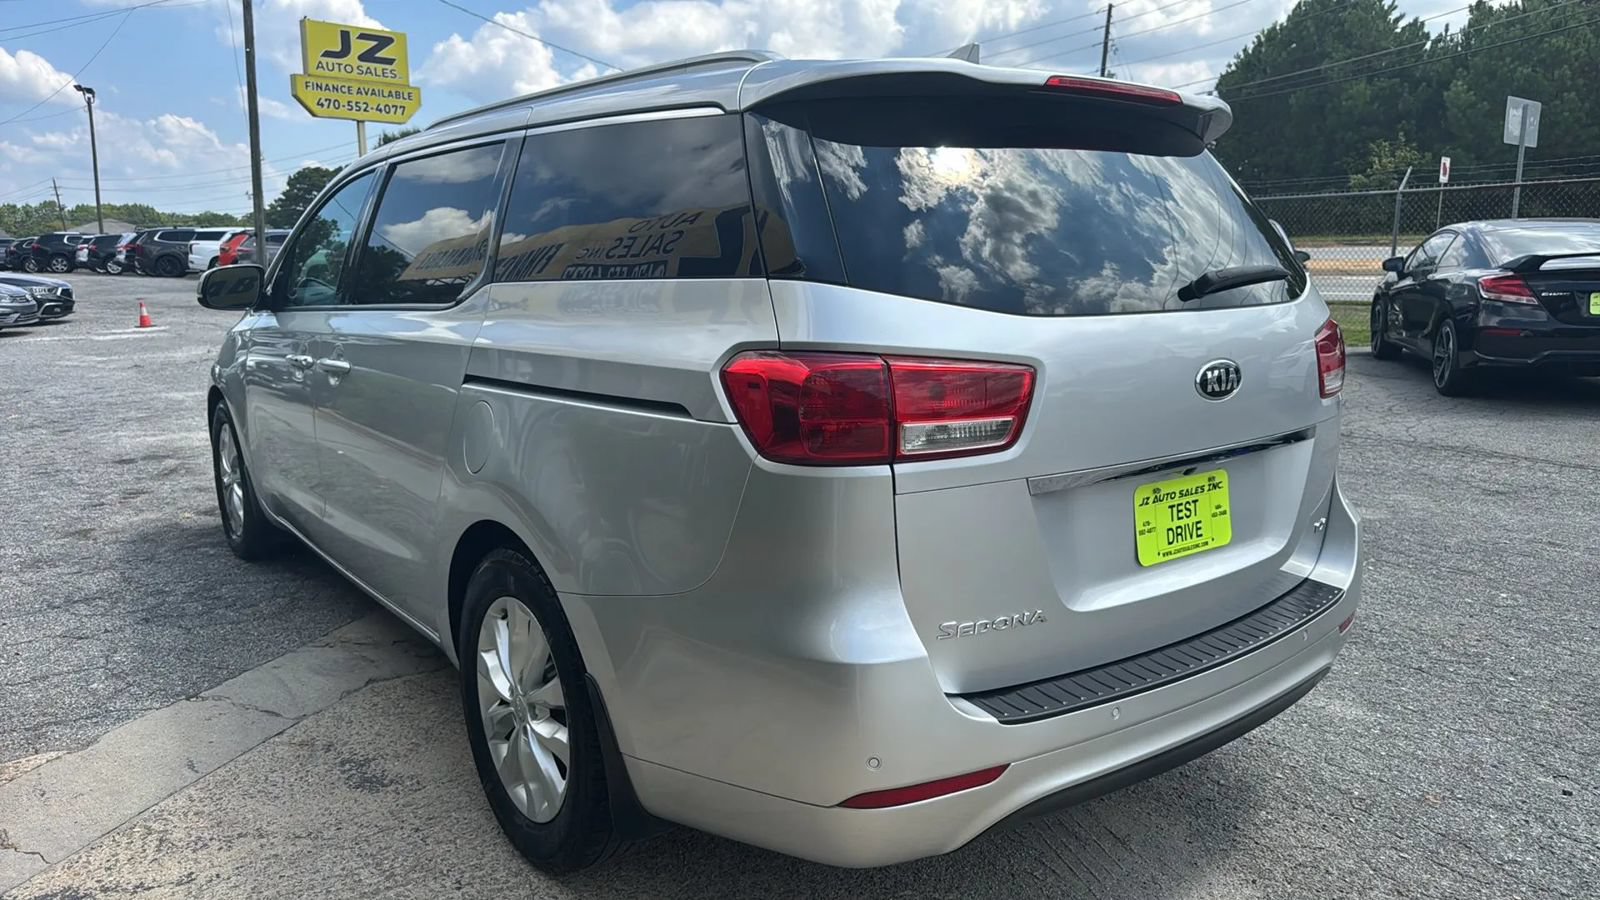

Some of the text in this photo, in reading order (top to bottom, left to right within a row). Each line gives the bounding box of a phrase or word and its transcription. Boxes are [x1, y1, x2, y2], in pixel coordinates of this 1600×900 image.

[320, 29, 398, 66] JZ
[316, 60, 397, 79] AUTO SALES
[305, 81, 414, 101] FINANCE AVAILABLE
[316, 97, 406, 116] 470-552-4077
[1205, 367, 1238, 393] KIA
[1138, 496, 1151, 507] JZ
[1152, 491, 1176, 504] AUTO
[1178, 484, 1205, 498] SALES
[1168, 499, 1199, 522] TEST
[1167, 520, 1203, 546] DRIVE
[936, 609, 1048, 640] SEDONA
